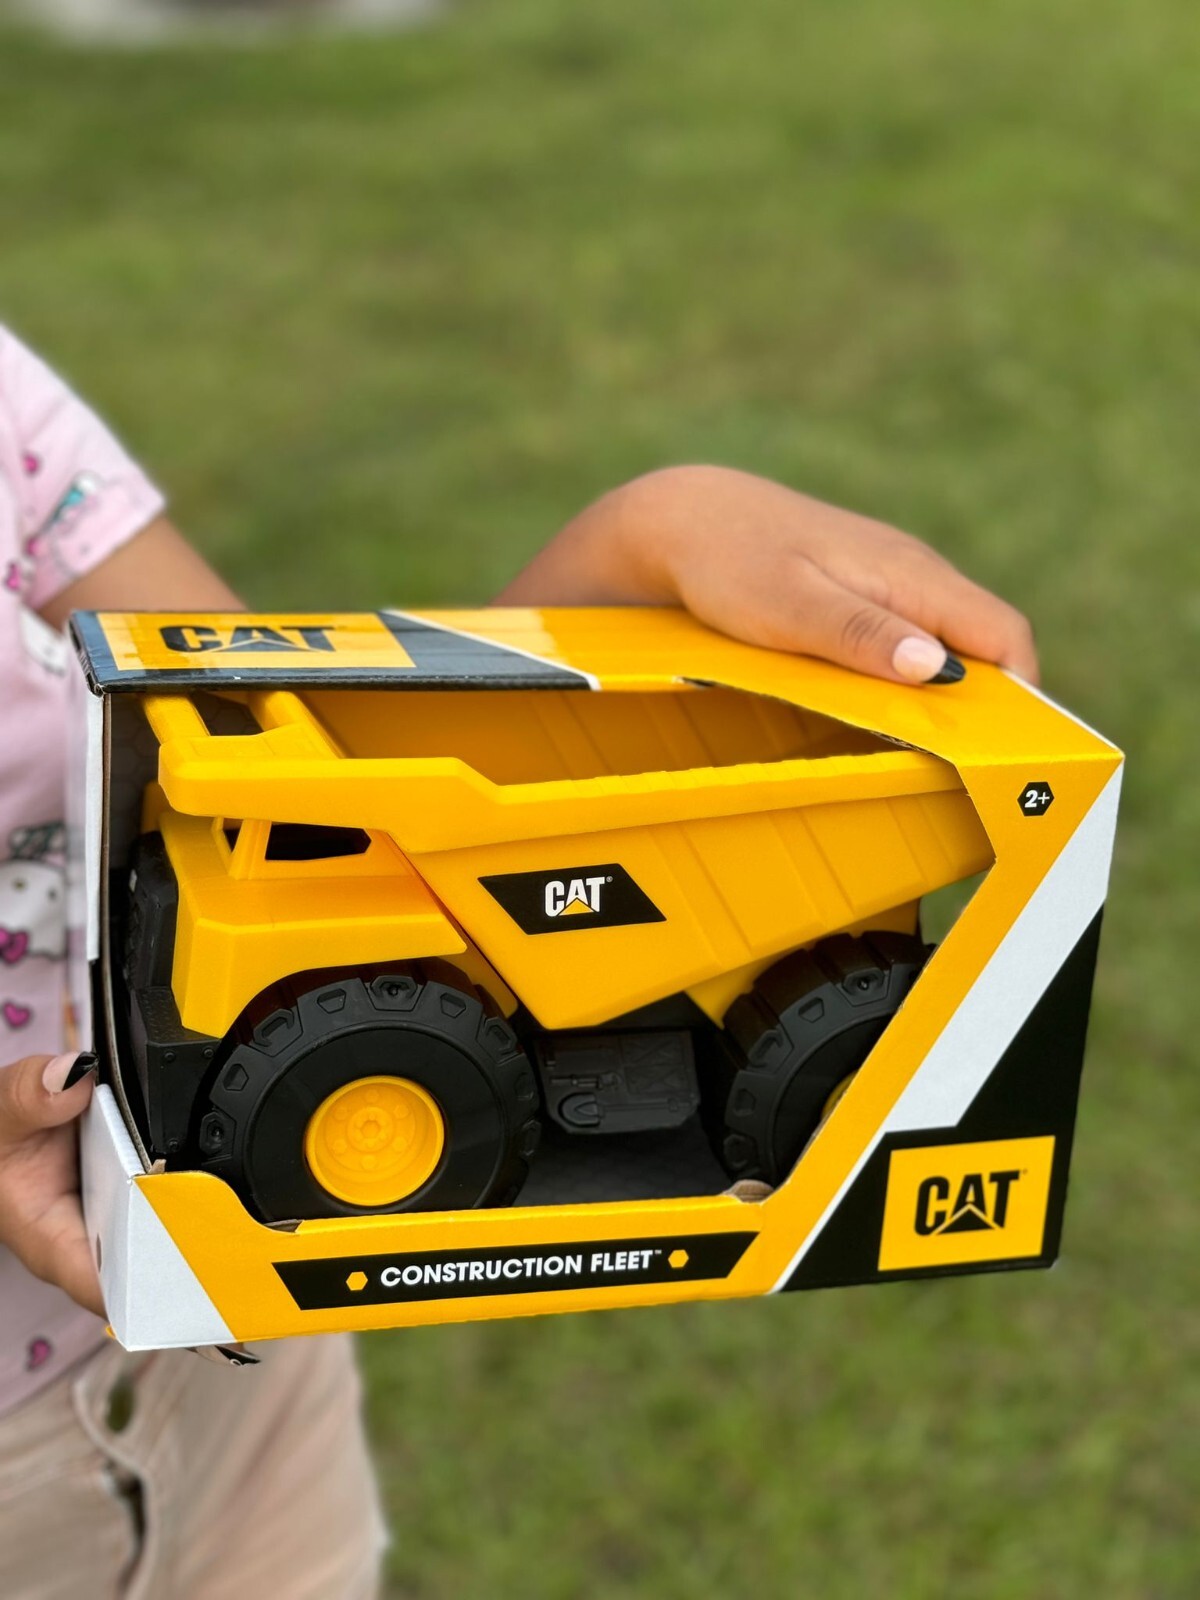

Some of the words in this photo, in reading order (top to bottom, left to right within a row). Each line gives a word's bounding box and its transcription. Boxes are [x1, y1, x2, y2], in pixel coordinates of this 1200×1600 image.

[160, 626, 336, 652] CAT
[1024, 789, 1050, 808] 2+
[545, 876, 605, 917] CAT
[914, 1169, 1020, 1237] CAT
[380, 1254, 582, 1287] CONSTRUCTION
